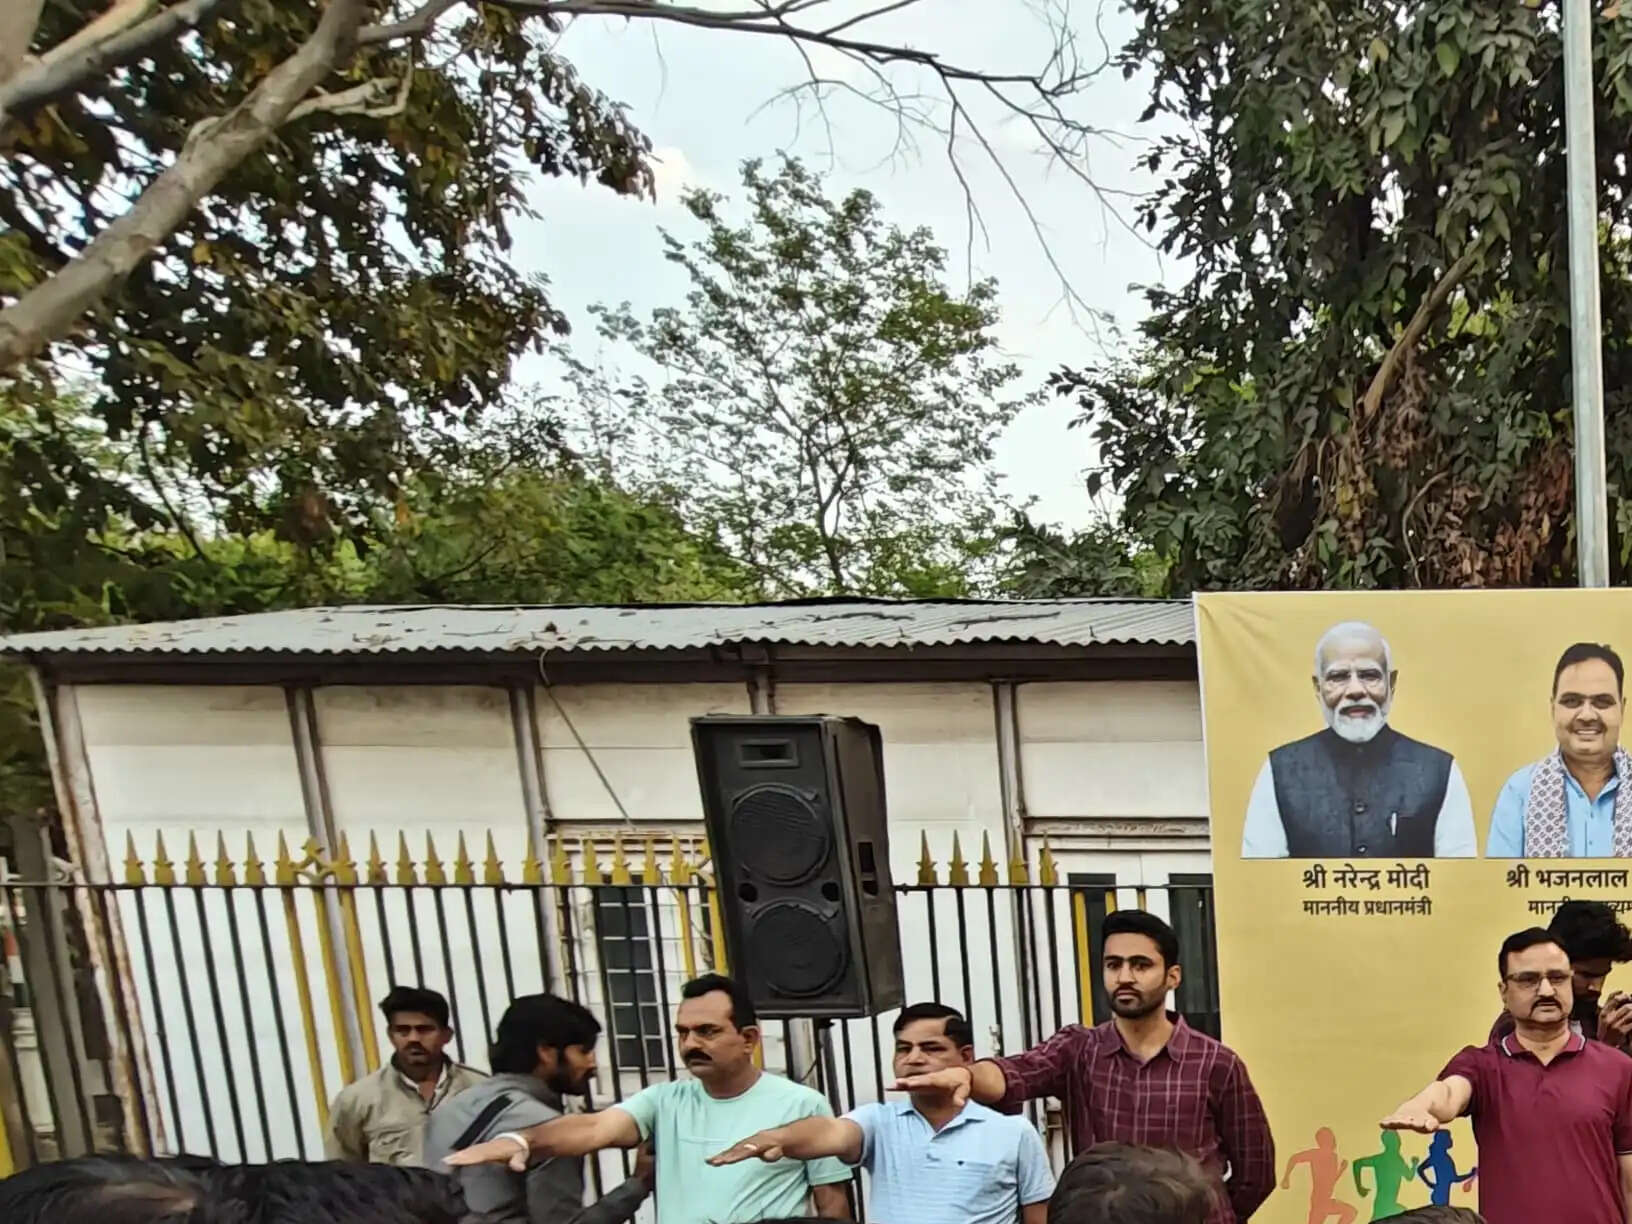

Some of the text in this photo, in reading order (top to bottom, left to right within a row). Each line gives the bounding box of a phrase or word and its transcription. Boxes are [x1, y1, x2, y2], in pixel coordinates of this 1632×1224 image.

[1303, 863, 1430, 890] श्री नरेन्द्र मोदी
[1506, 864, 1530, 888] श्री
[1536, 869, 1628, 888] भजनलाल
[1303, 896, 1432, 915] माननीय प्रधानमंत्री
